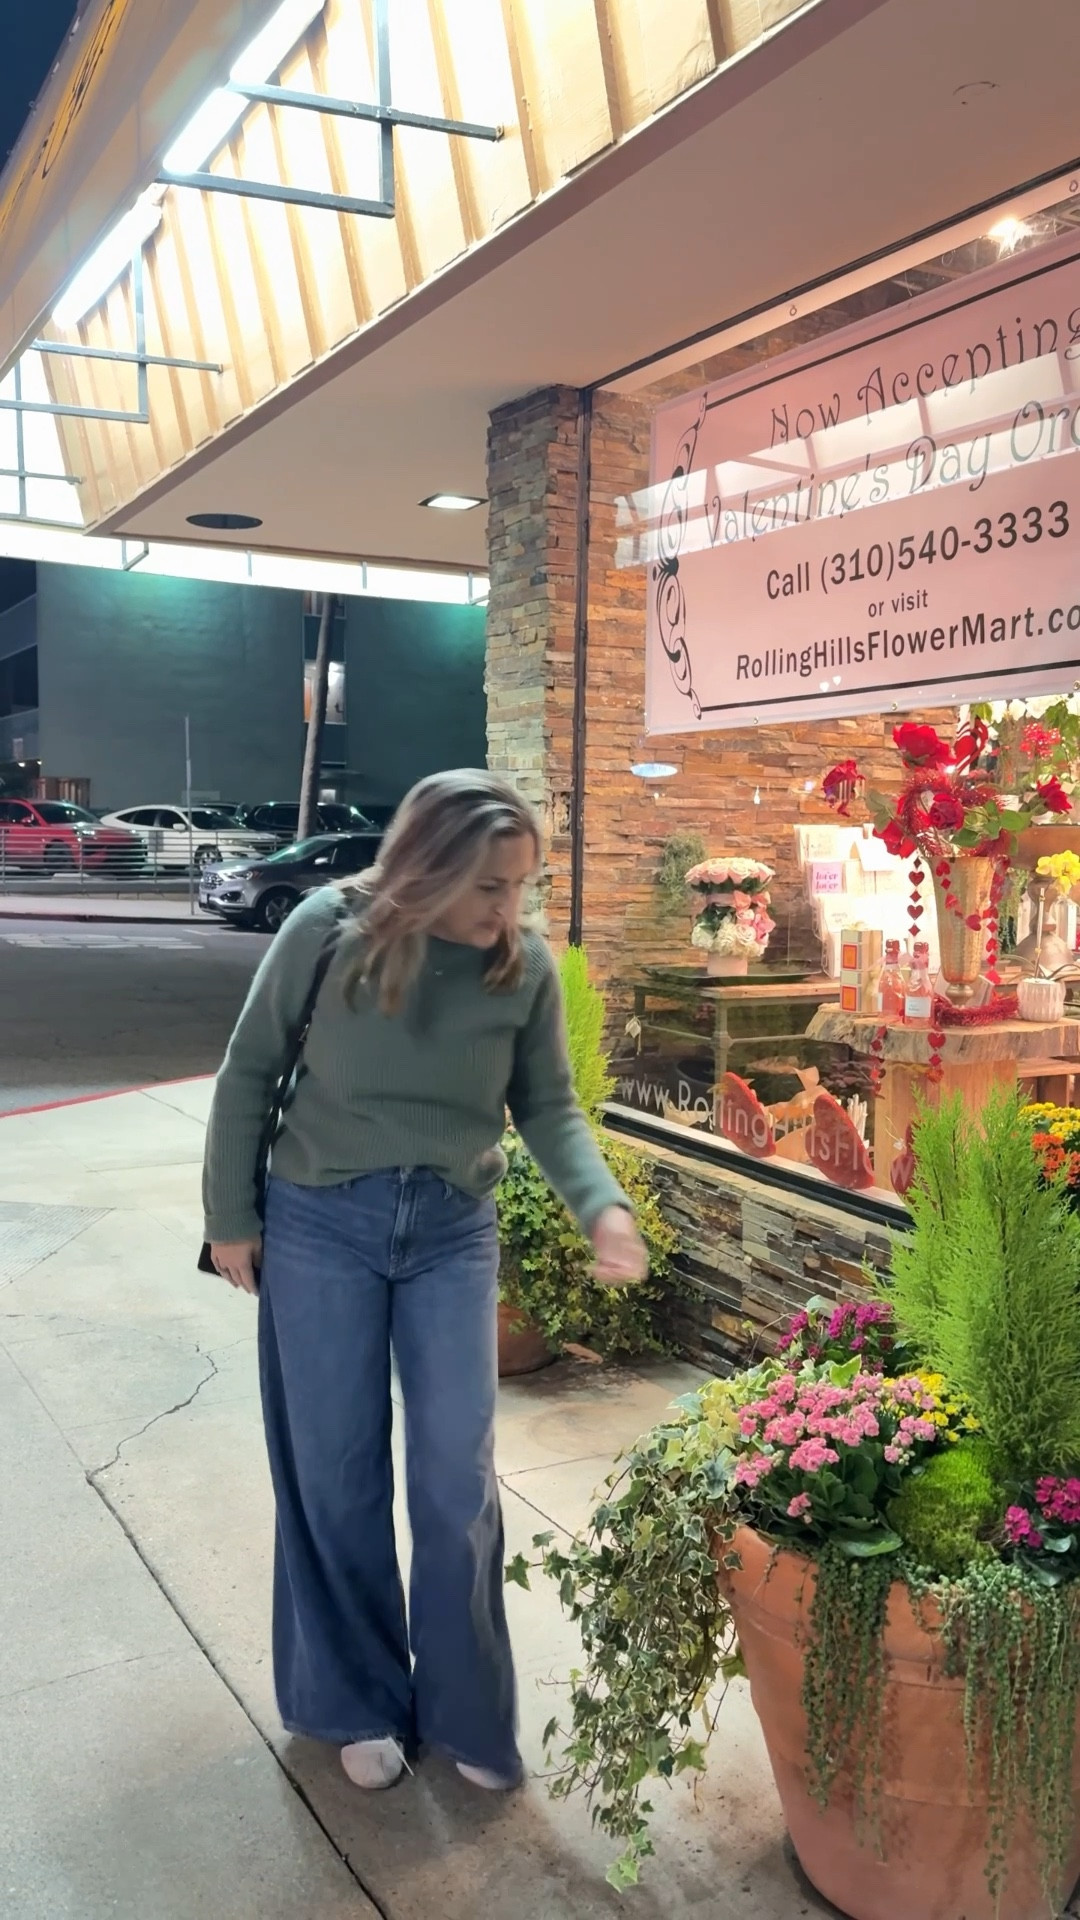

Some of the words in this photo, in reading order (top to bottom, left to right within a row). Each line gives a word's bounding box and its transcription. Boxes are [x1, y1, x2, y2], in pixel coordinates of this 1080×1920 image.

[771, 393, 841, 448] Now
[857, 308, 1080, 425] Accepting
[704, 453, 890, 549] Valentine's
[906, 432, 993, 494] Day
[766, 561, 810, 600] Call
[821, 500, 1070, 594] (310)540-3333
[868, 600, 884, 618] or
[891, 588, 929, 614] visit
